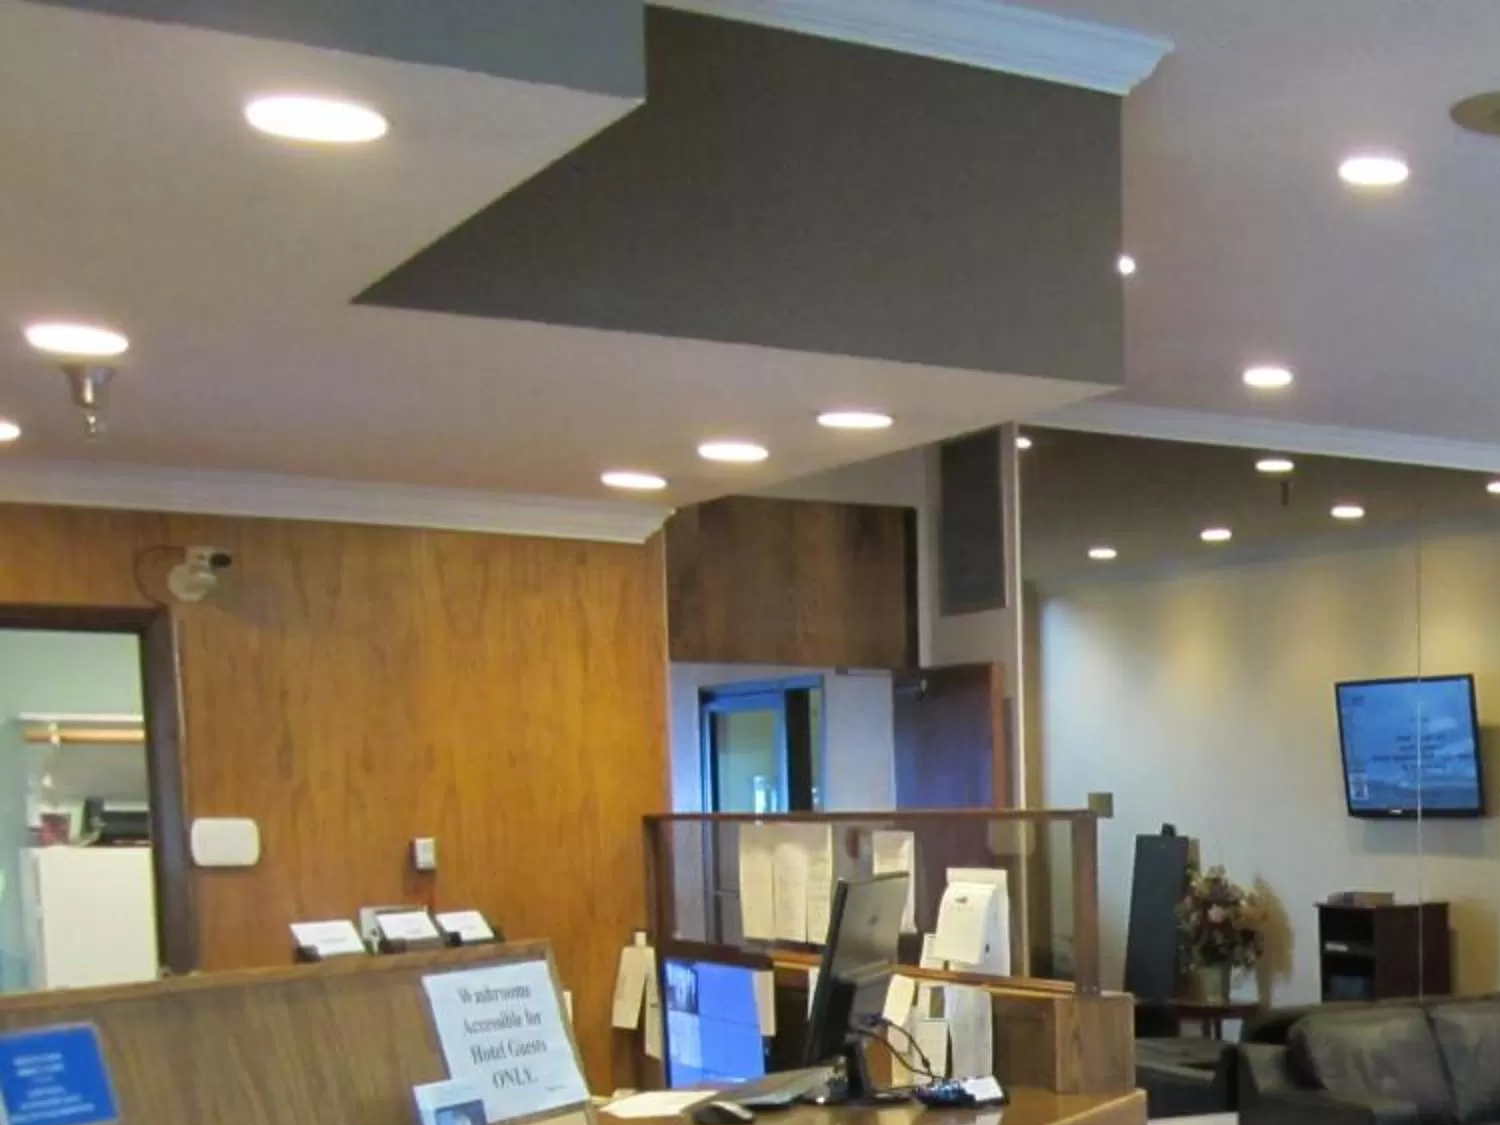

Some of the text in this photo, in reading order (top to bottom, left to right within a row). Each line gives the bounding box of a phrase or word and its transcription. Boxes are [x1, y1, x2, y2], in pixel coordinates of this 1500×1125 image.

[456, 985, 531, 1005] Washrooms
[463, 1009, 522, 1035] Accessible
[469, 1038, 547, 1066] Hotel Guests
